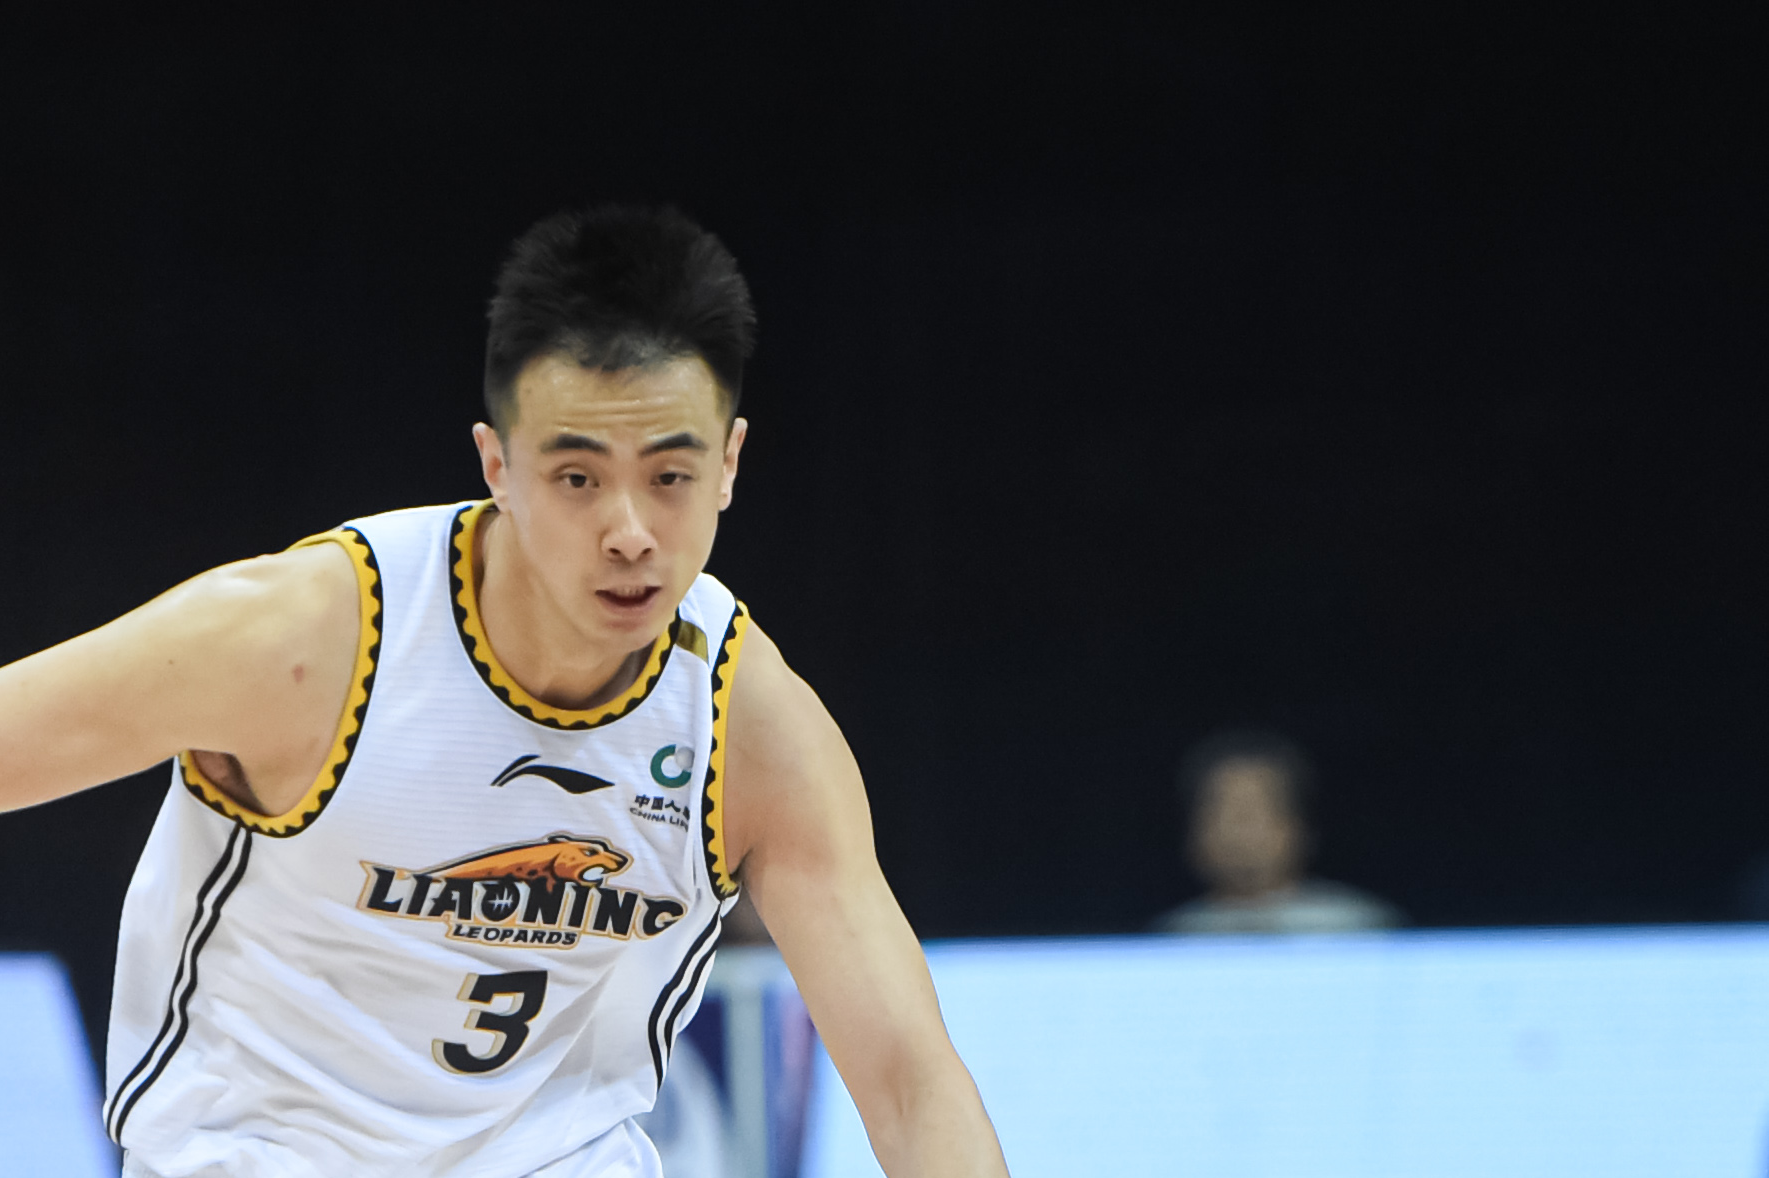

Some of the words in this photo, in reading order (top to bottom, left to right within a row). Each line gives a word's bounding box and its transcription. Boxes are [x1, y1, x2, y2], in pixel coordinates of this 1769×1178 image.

[629, 807, 666, 823] CHINA
[669, 815, 689, 832] LIF
[359, 864, 687, 939] LIAONING
[452, 922, 579, 946] LEOPARDS
[432, 970, 548, 1073] 3
